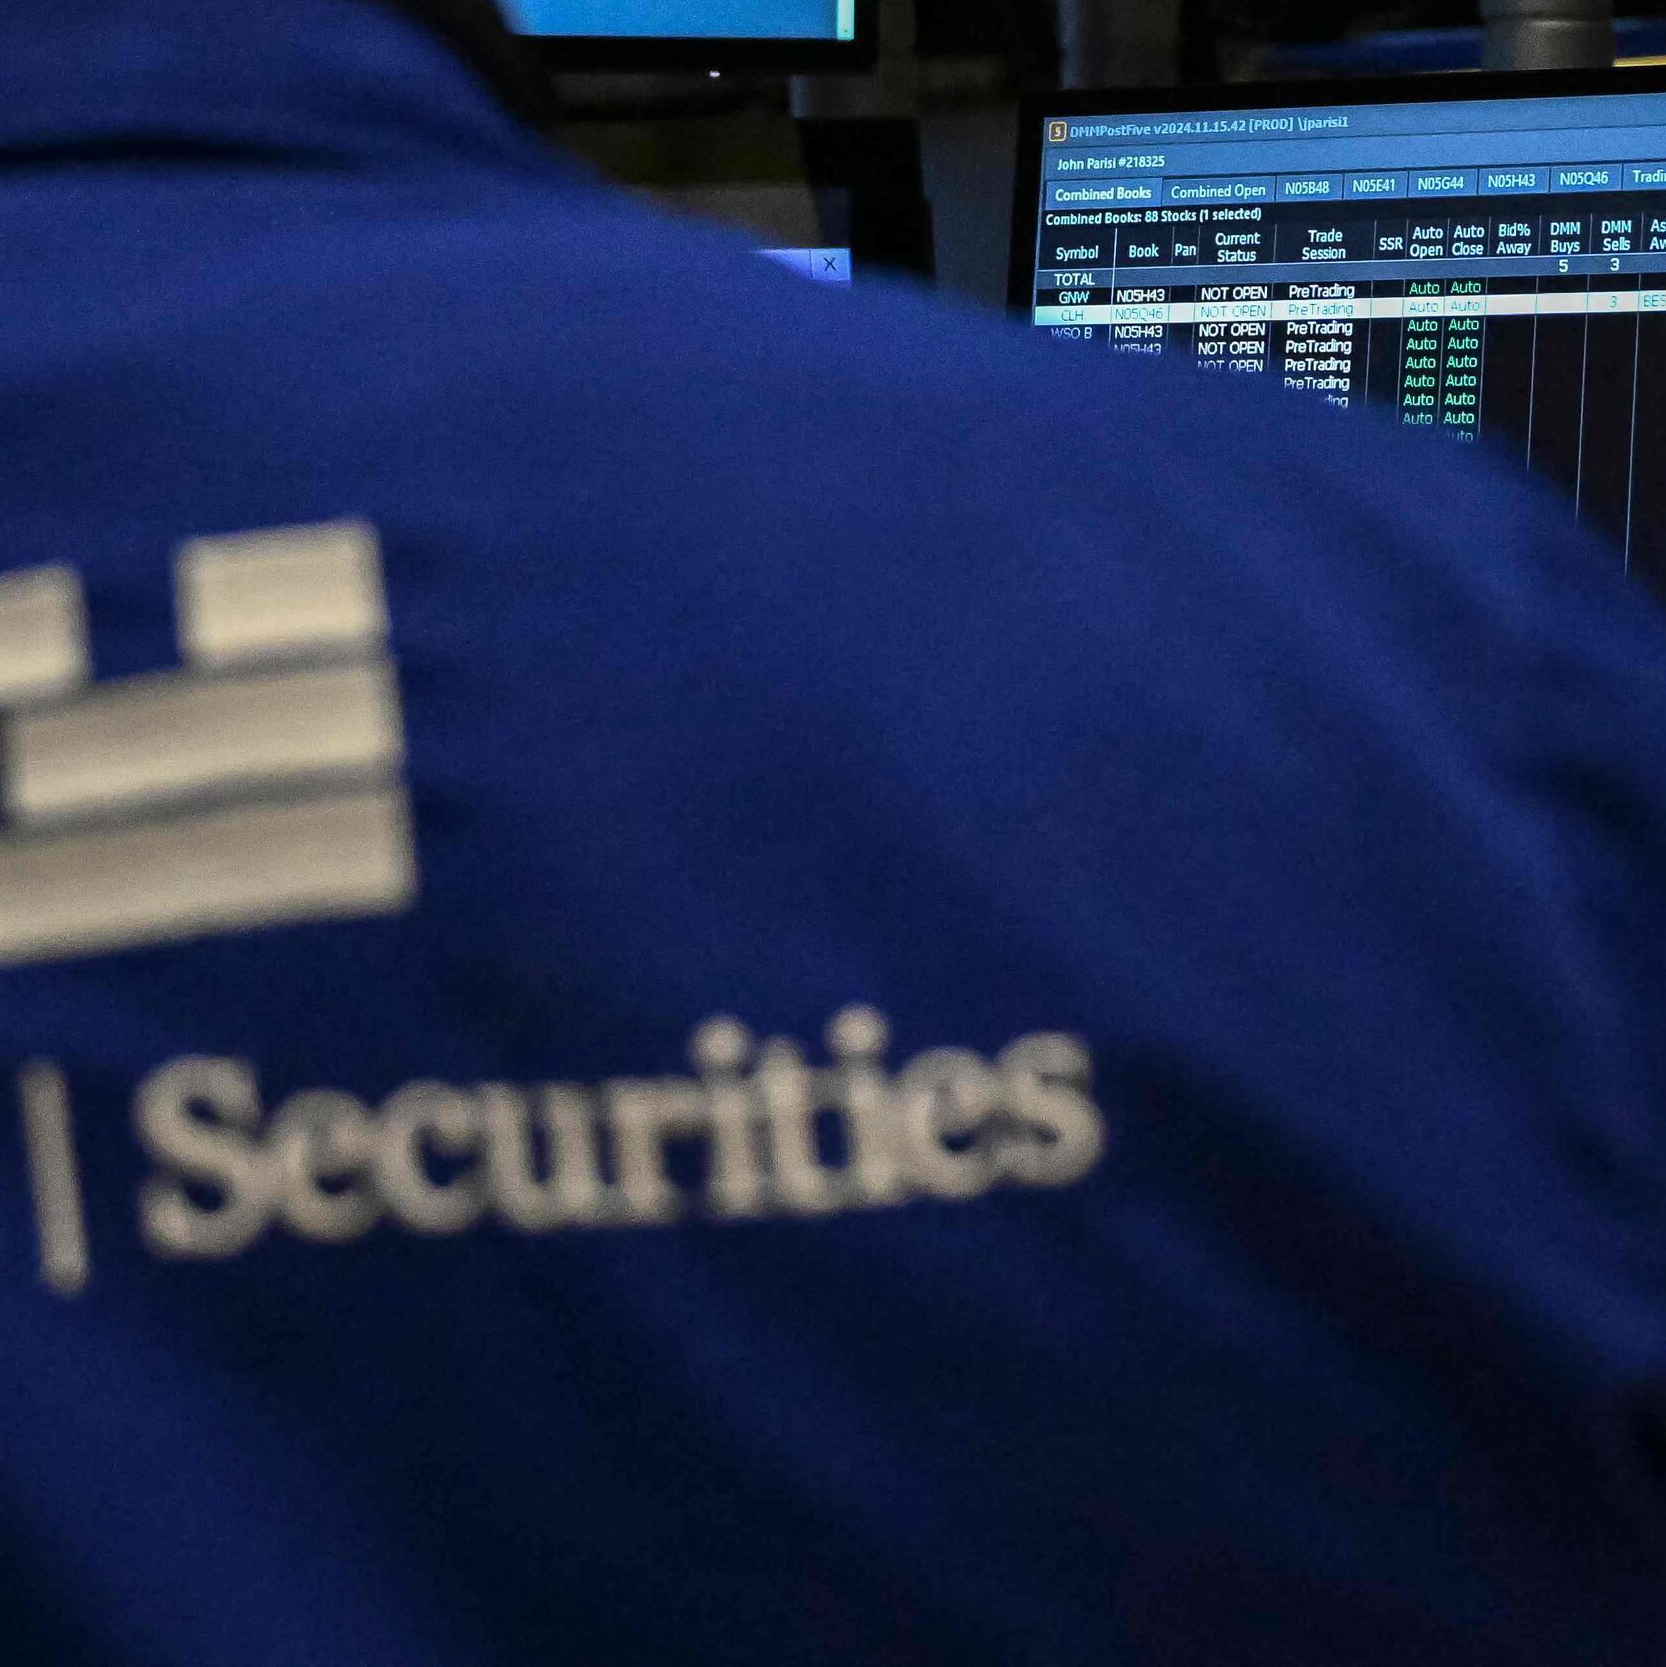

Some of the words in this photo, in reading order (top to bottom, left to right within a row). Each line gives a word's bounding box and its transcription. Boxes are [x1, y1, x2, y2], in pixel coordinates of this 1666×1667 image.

[1070, 124, 1151, 138] DMMPostFive
[1153, 120, 1246, 135] v2024.11.15.42
[1249, 118, 1293, 133] [PROD]
[1058, 158, 1084, 171] John
[1088, 156, 1116, 169] Parisi
[1119, 155, 1165, 167] #218325
[1418, 176, 1464, 190] N05G44
[1488, 174, 1536, 188] N05H43
[1560, 172, 1608, 185] N05Q46
[1055, 189, 1114, 201] Combined
[1117, 187, 1151, 199] Books
[1171, 186, 1231, 198] Combined
[1234, 185, 1266, 200] Open
[1285, 182, 1329, 194] N05B48
[1046, 213, 1101, 226] Combined
[1105, 212, 1142, 224] Books:
[1145, 211, 1158, 222] 88
[1161, 210, 1196, 222] Stocks
[1212, 208, 1261, 221] selected)
[1216, 233, 1260, 246] Current
[1308, 230, 1342, 243] Trade
[1056, 245, 1099, 261] Symbol
[1129, 244, 1158, 257] Book
[1175, 244, 1197, 257] Pan
[1217, 249, 1256, 263] Status
[1302, 247, 1346, 261] Session
[1379, 237, 1403, 250] SSR
[1055, 273, 1095, 286] TOTAL
[1059, 291, 1090, 303] GNW
[1201, 287, 1229, 300] NOT
[1233, 286, 1268, 299] OPEN
[1289, 284, 1355, 299] PreTrading
[1410, 282, 1439, 295] Auto
[1451, 281, 1481, 294] Auto
[137, 1005, 1107, 1264] Securities
